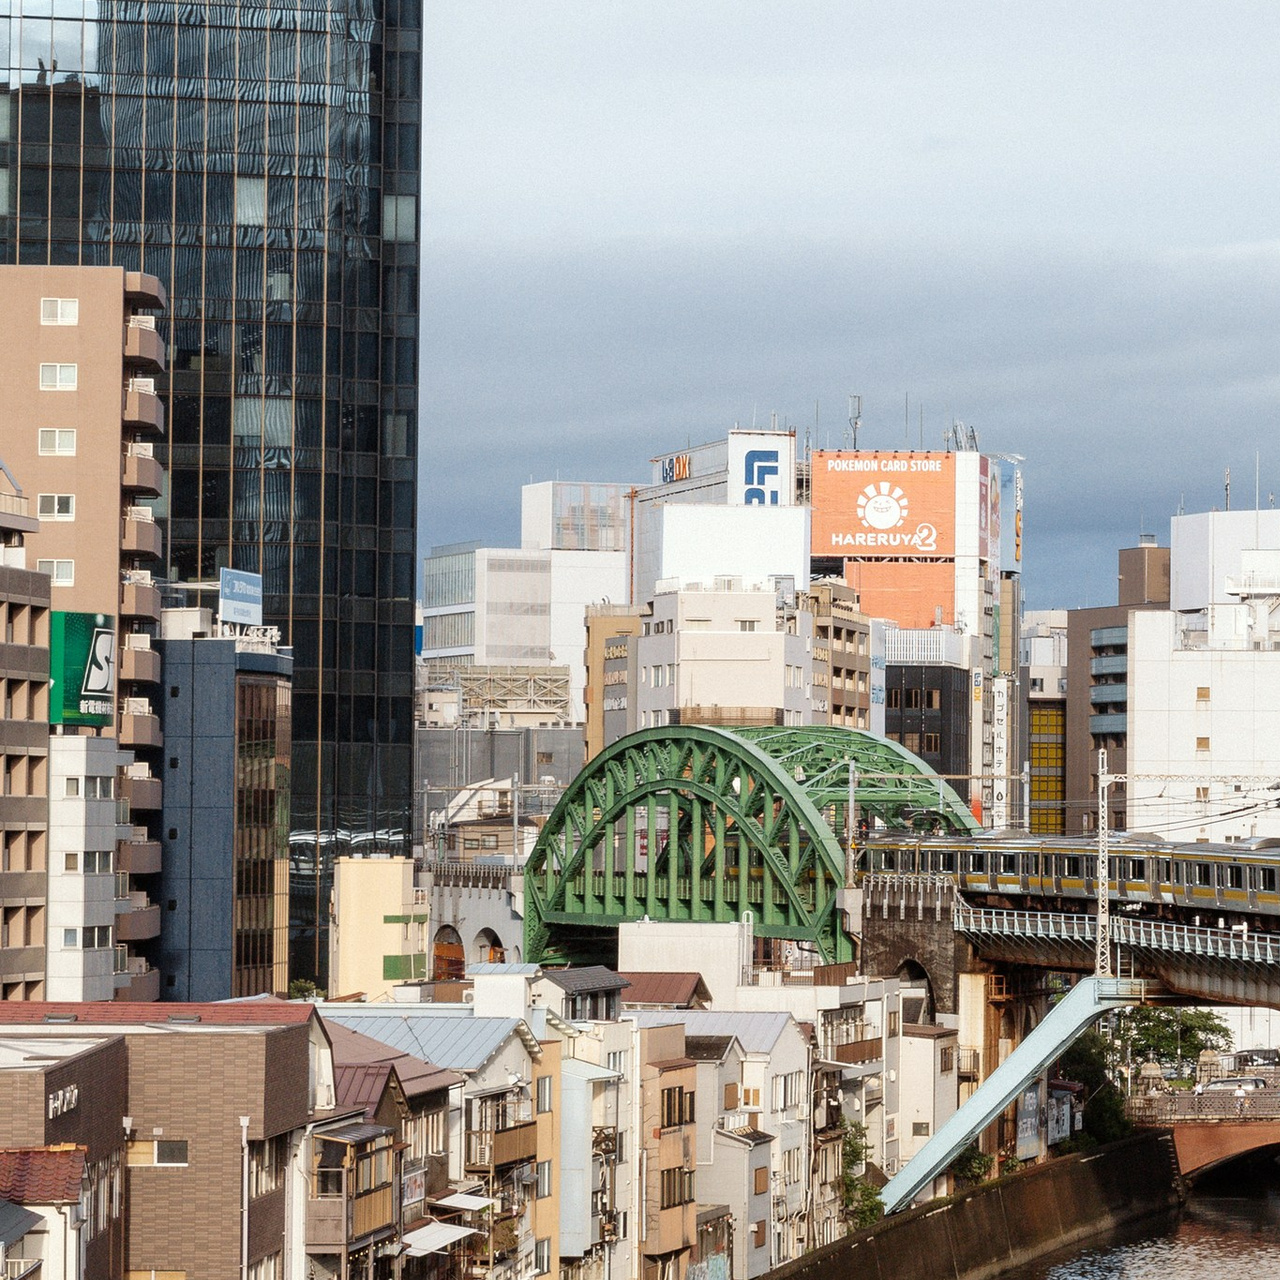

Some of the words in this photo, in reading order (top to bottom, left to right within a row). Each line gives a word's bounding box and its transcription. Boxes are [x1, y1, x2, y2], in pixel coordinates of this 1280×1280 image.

[827, 460, 878, 471] POKEMON
[880, 460, 908, 471] CARD
[910, 460, 942, 471] STORE
[831, 533, 922, 546] HARERUYA
[916, 523, 937, 551] 2
